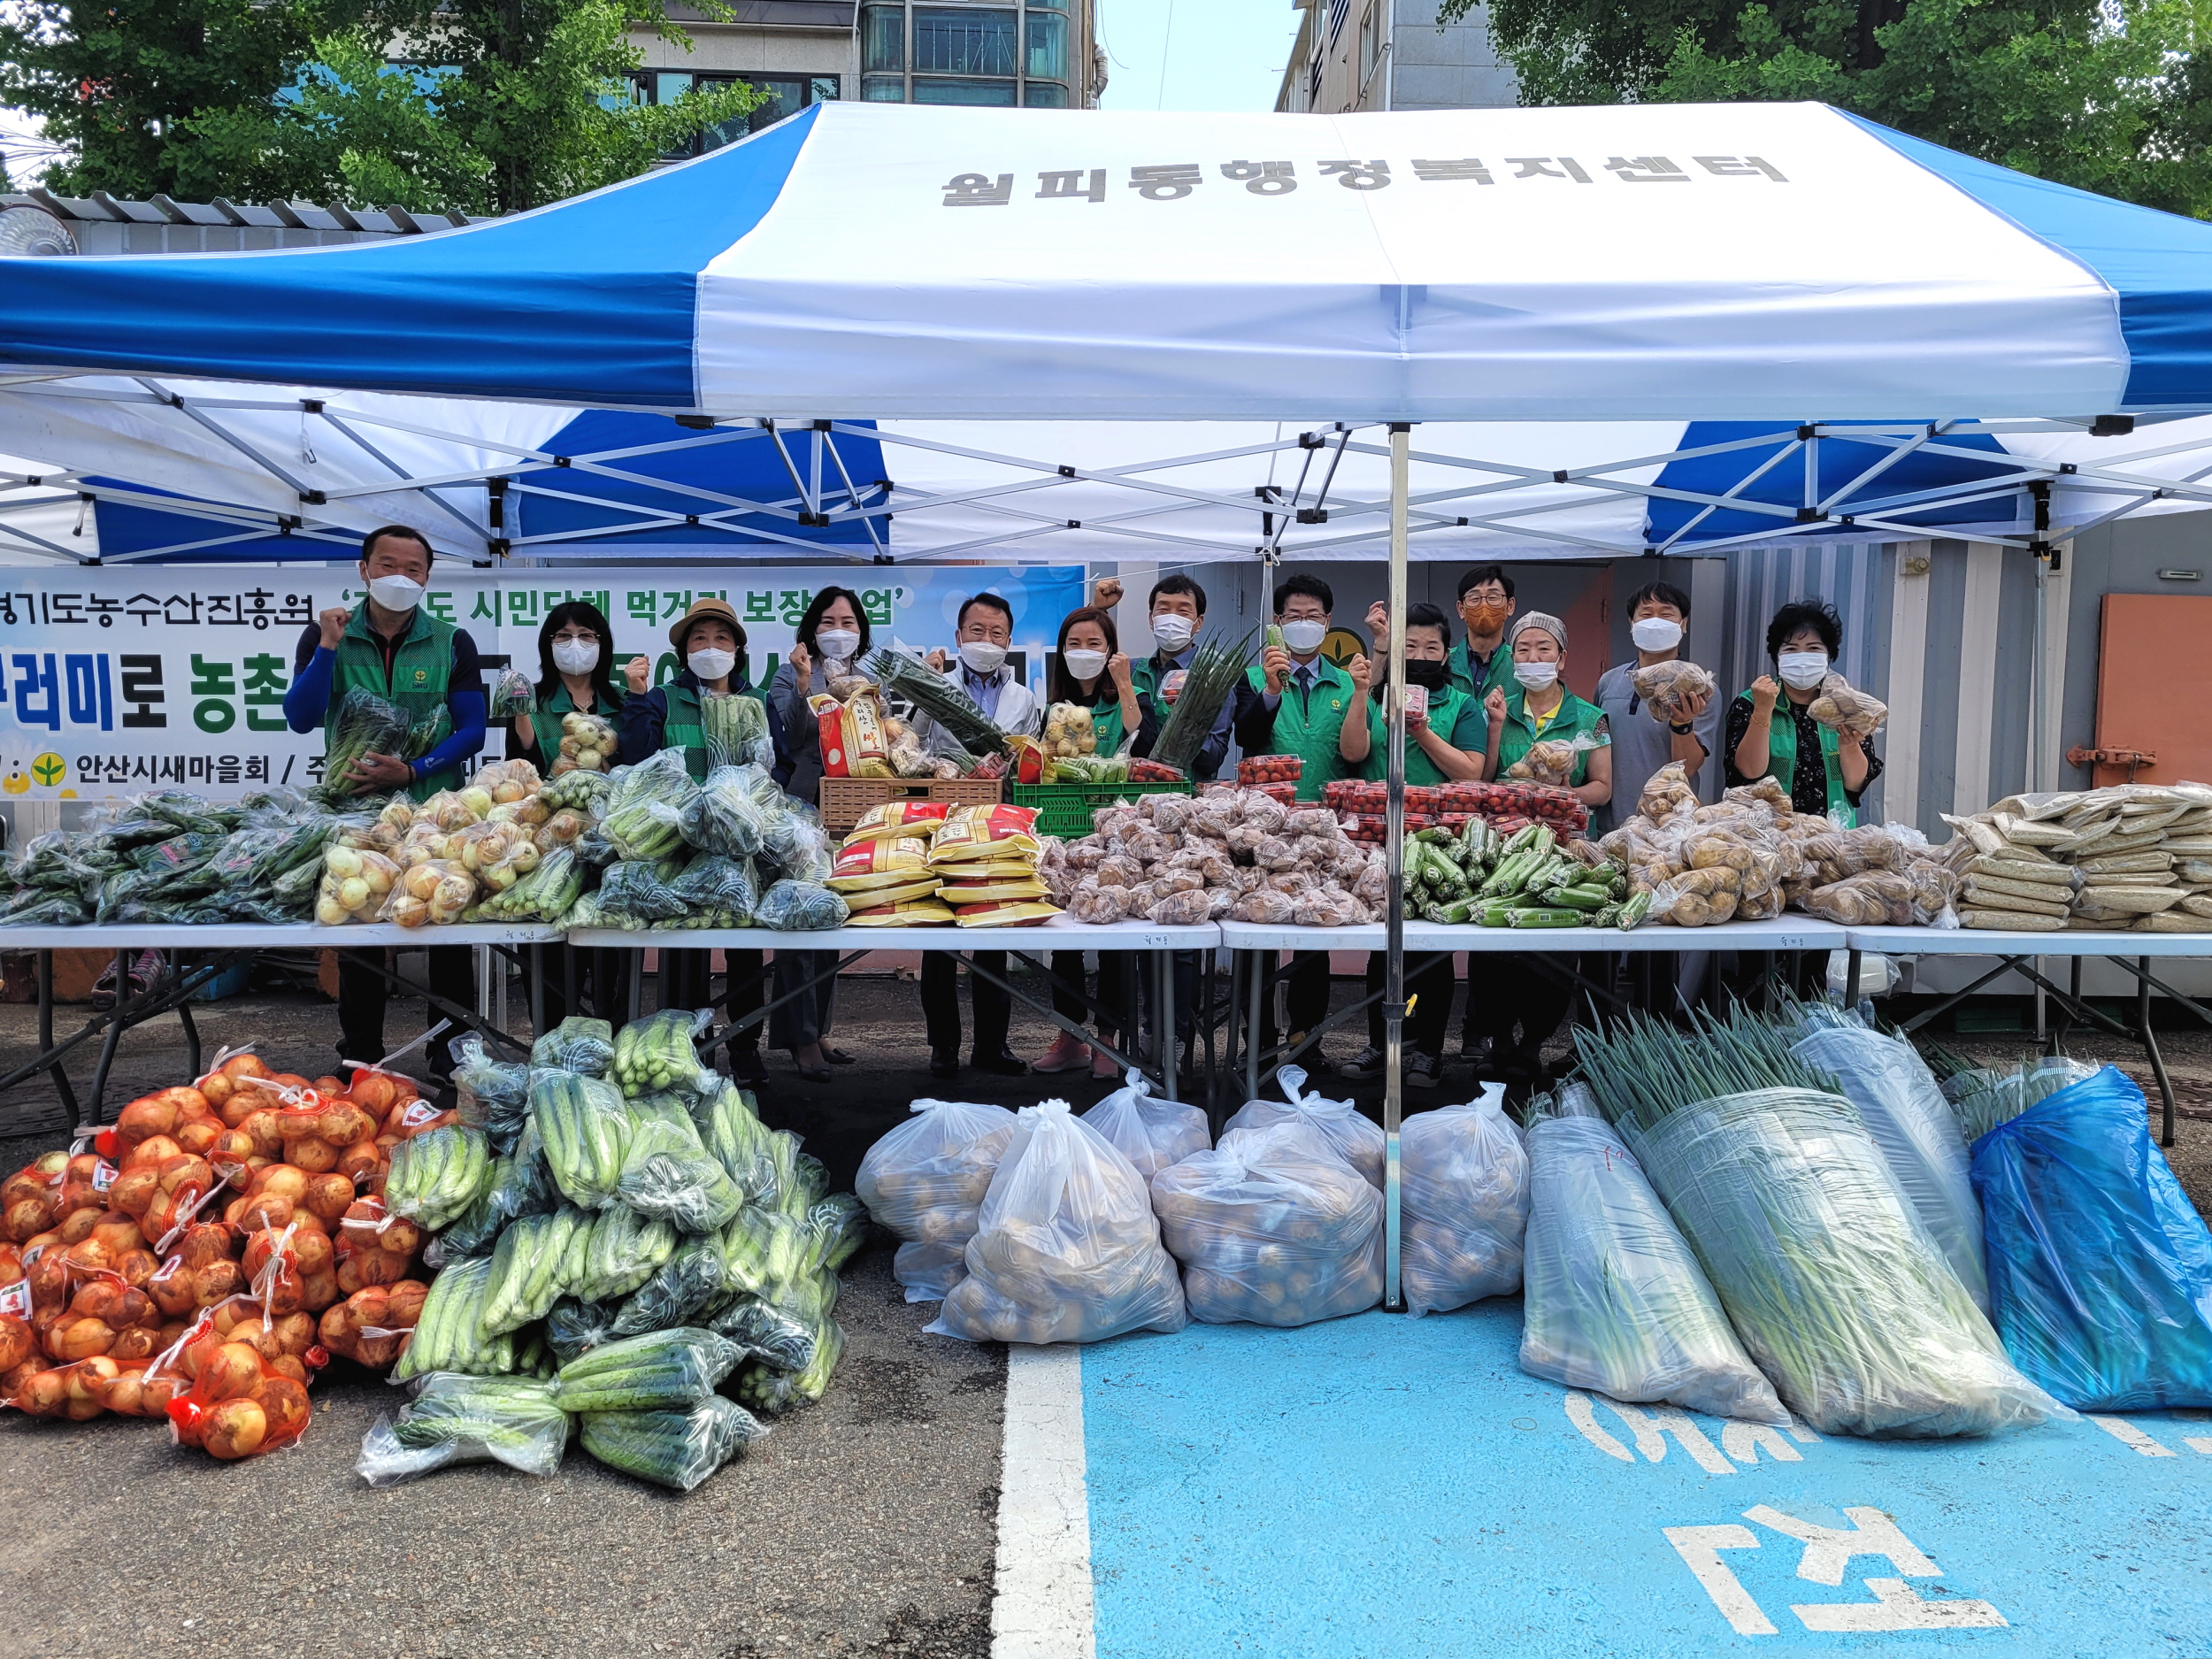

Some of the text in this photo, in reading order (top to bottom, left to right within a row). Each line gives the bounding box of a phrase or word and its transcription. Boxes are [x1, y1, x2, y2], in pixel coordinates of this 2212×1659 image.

[627, 590, 726, 626] 먹거
[743, 588, 903, 626] 보장업’
[0, 653, 167, 731] 러미로
[76, 754, 269, 785] 안산시새마을회
